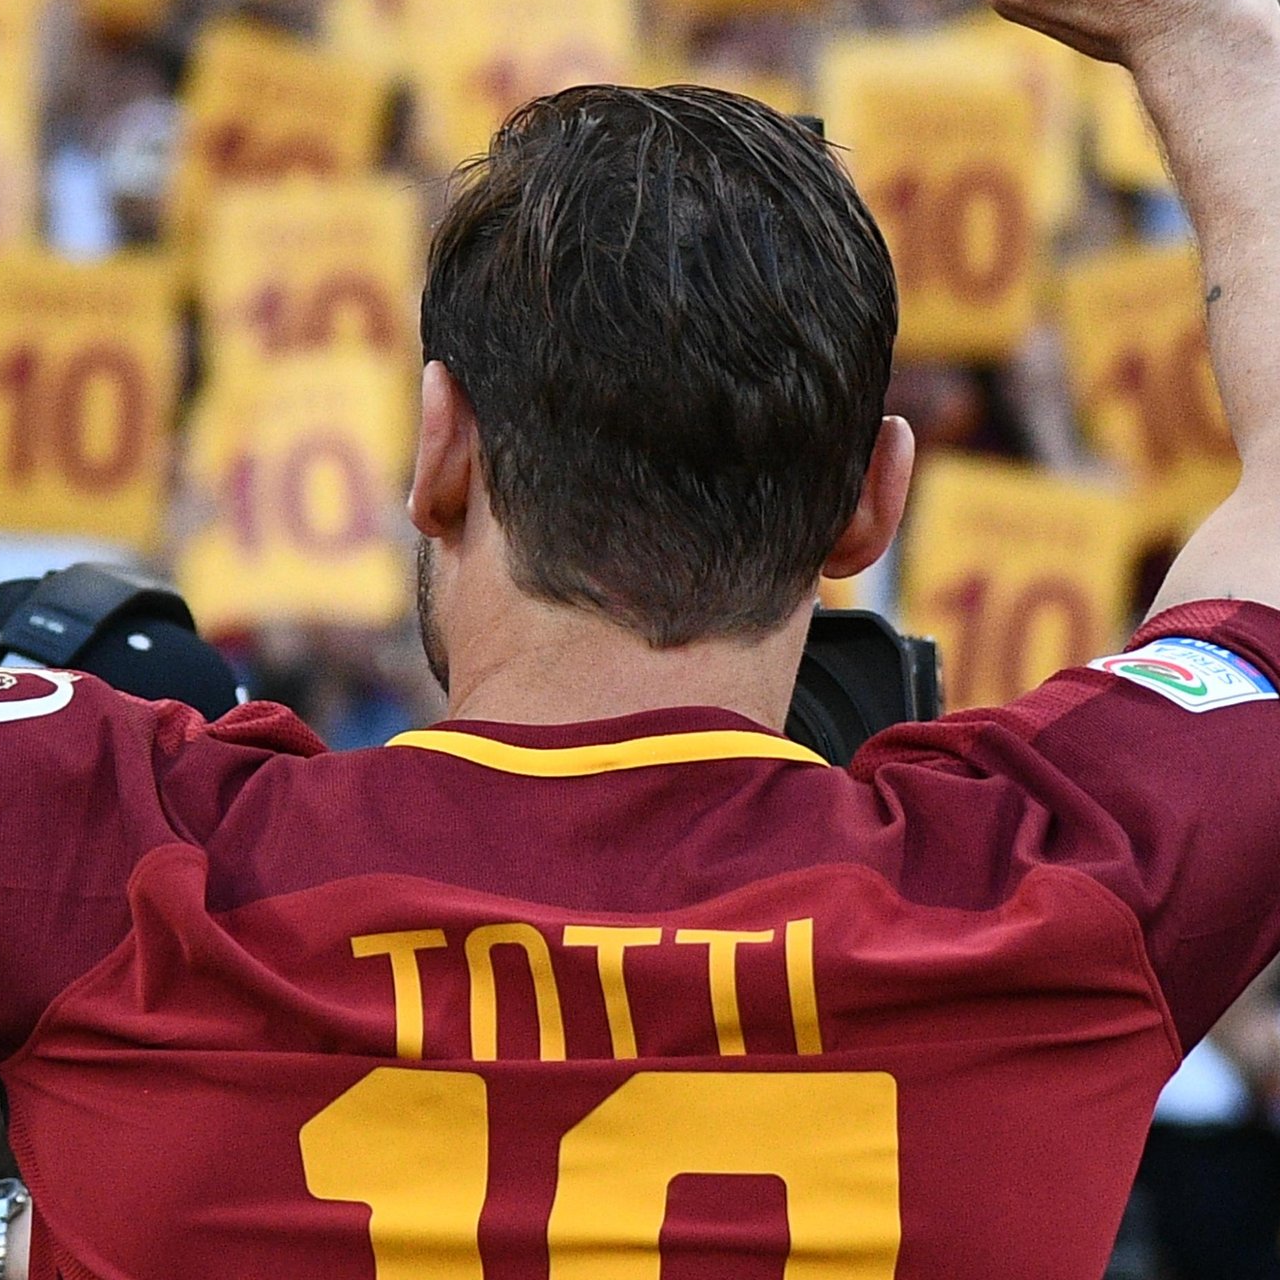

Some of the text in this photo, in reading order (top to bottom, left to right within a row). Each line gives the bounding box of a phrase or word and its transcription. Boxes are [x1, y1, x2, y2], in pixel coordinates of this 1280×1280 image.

[225, 430, 382, 560] 10
[934, 568, 1106, 710] 10
[1176, 649, 1240, 685] SERIE
[351, 916, 824, 1062] TOTTI
